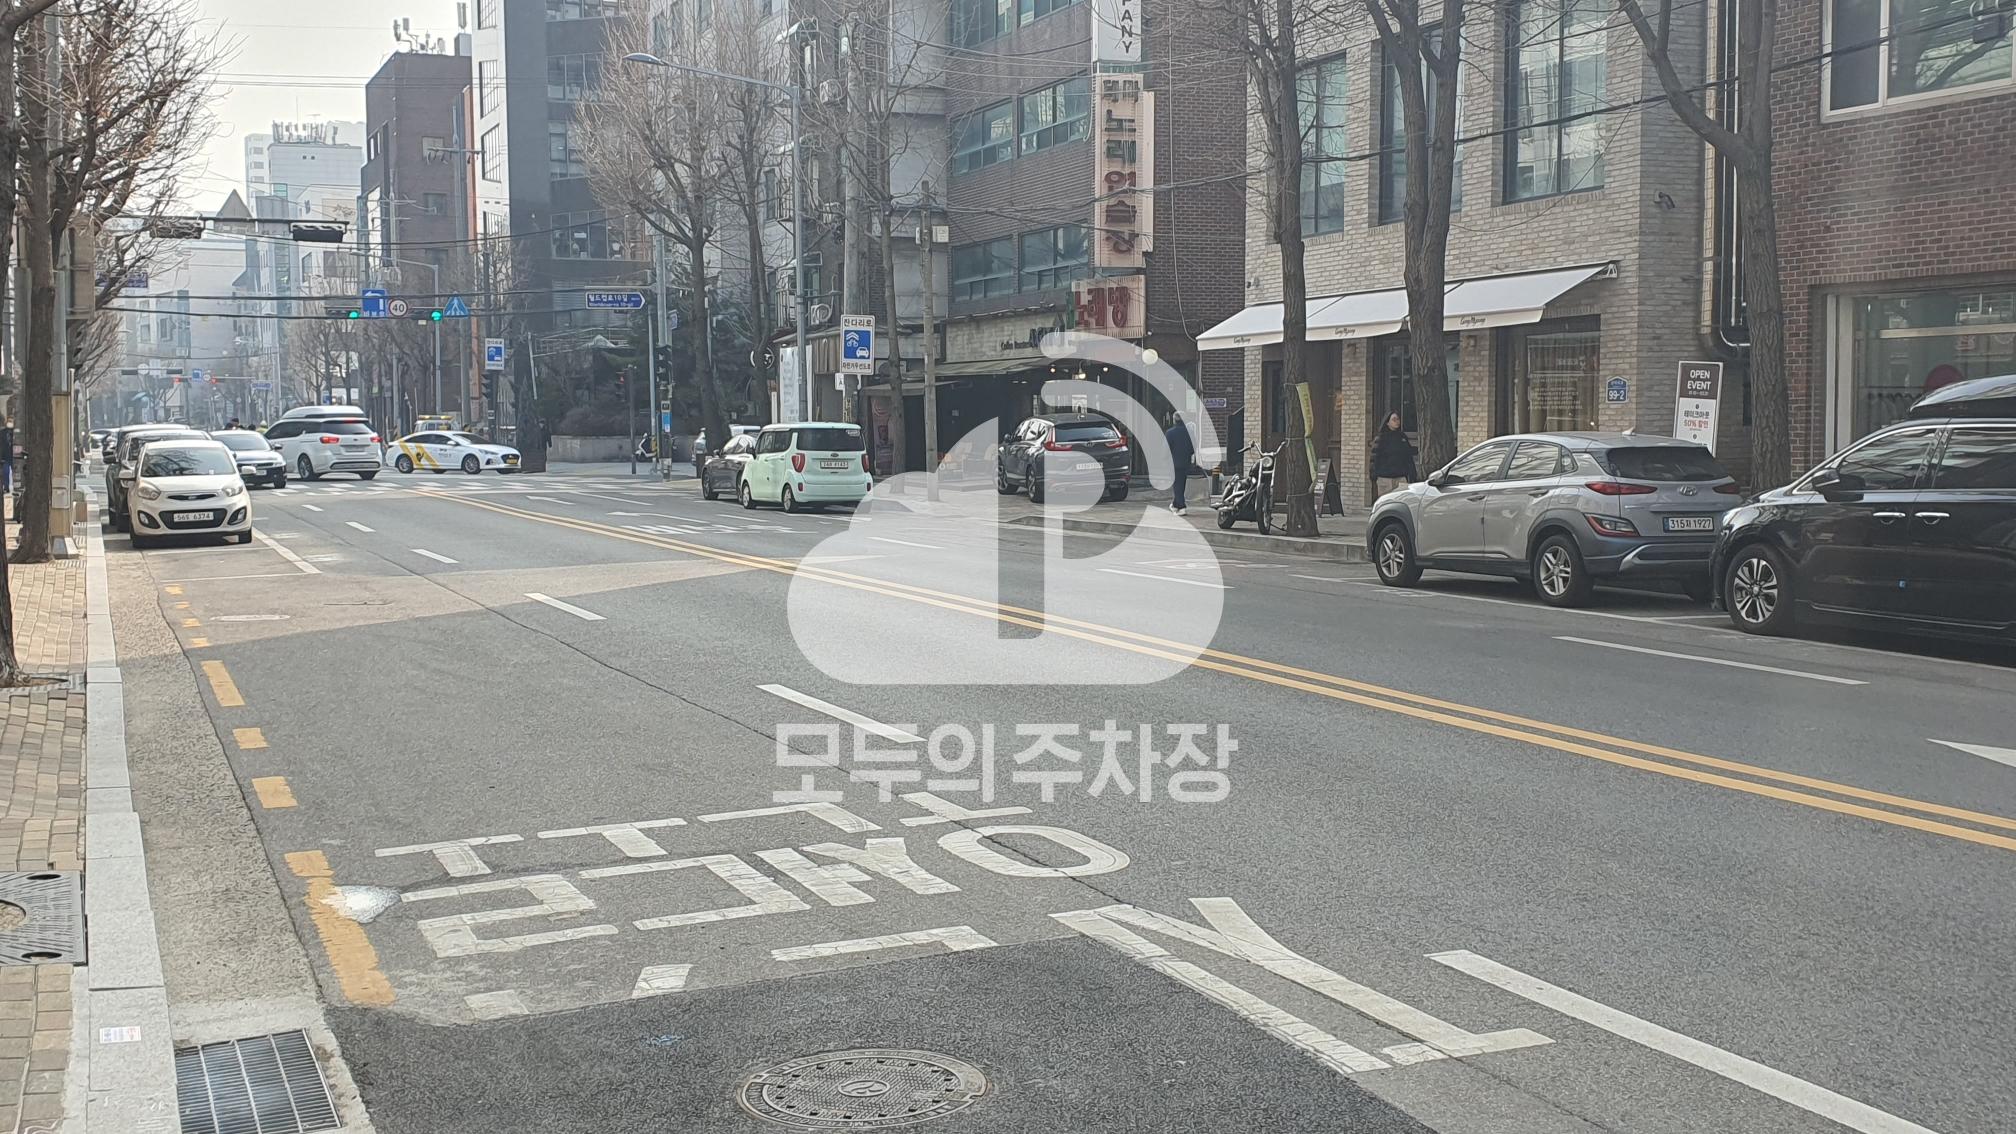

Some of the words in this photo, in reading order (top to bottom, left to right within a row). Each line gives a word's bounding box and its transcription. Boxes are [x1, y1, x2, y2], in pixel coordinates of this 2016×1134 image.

[1121, 0, 1133, 53] ANY
[391, 303, 405, 313] 40
[1074, 286, 1129, 328] 노래방
[843, 318, 873, 328] 잔다리로
[1689, 369, 1711, 379] OPEN
[1687, 380, 1712, 391] EVENT
[1608, 390, 1625, 400] 99-2
